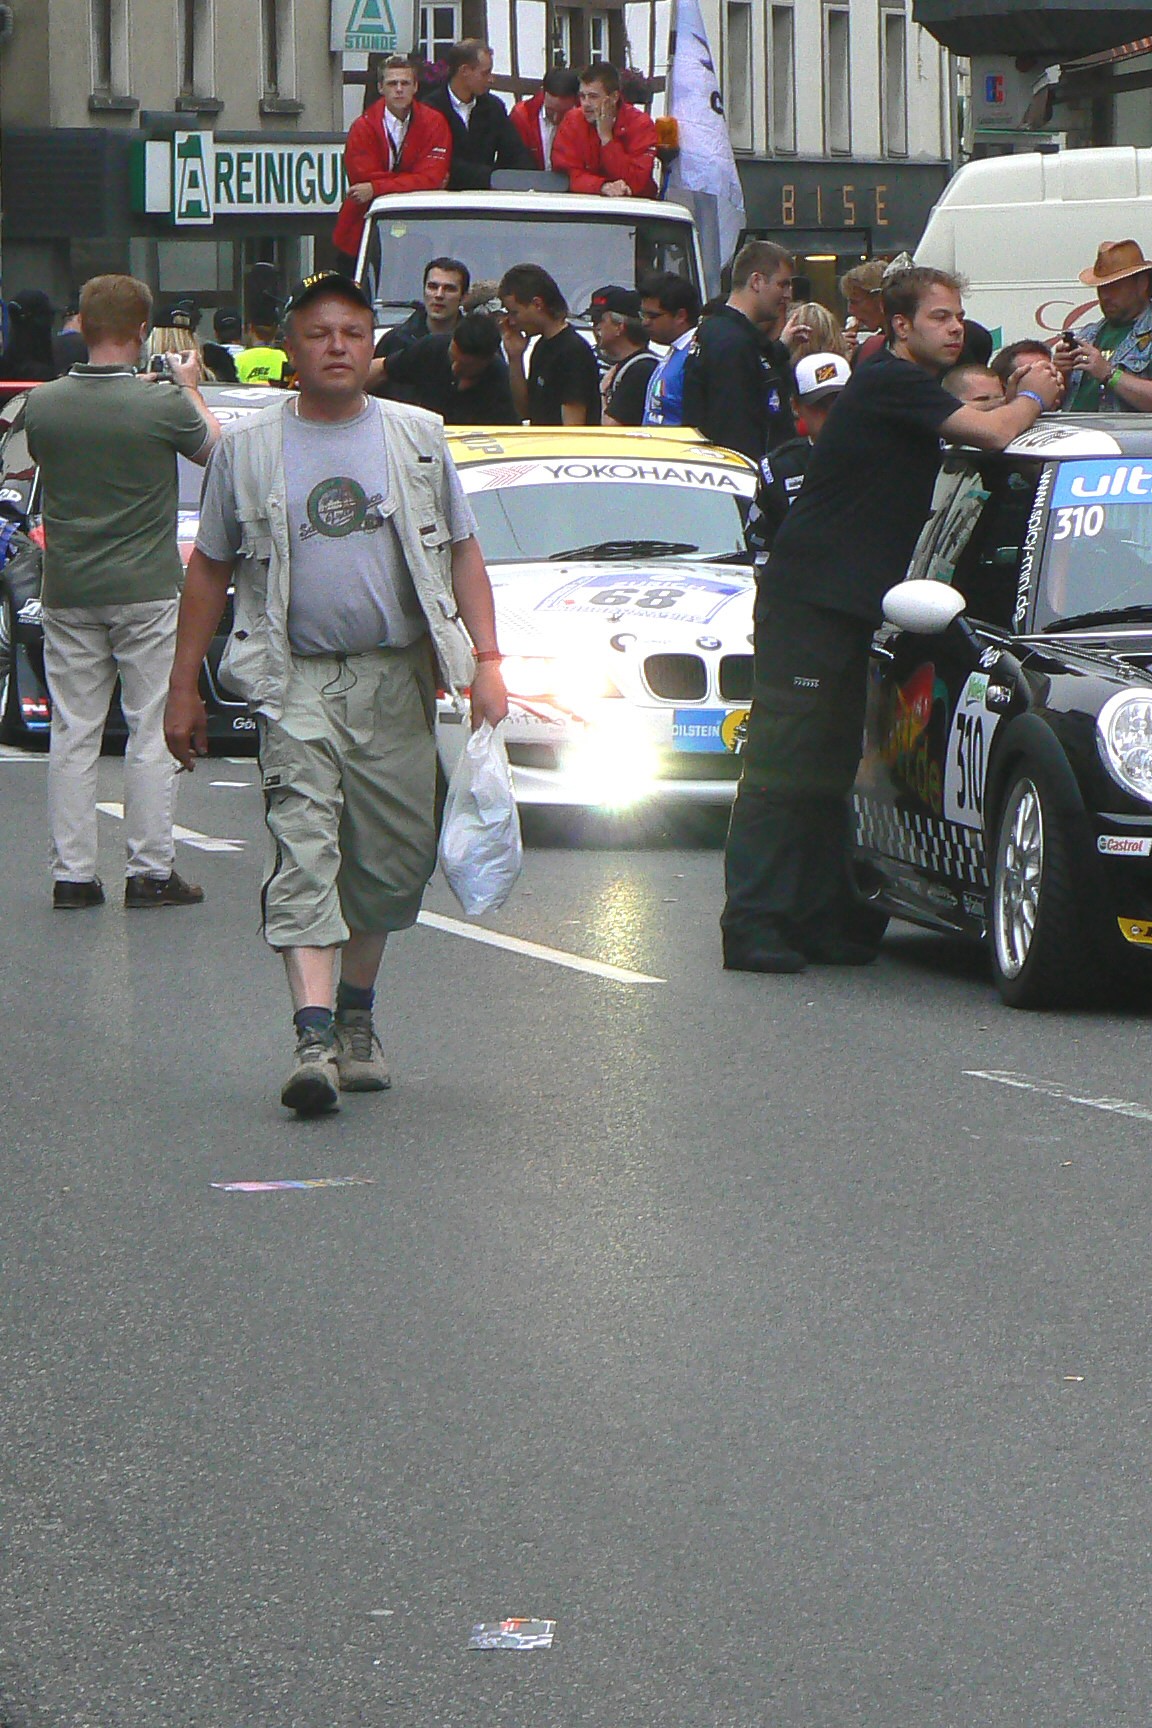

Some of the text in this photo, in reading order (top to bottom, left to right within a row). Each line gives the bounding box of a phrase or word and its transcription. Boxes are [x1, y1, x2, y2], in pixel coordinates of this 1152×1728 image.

[345, 35, 396, 49] STUNDE
[543, 463, 741, 491] YOKOHAMA
[1053, 505, 1105, 541] 310
[1014, 468, 1053, 622] www.spicy-mini.de
[588, 588, 686, 610] 68
[956, 712, 982, 815] 310
[1106, 838, 1144, 852] Castrol
